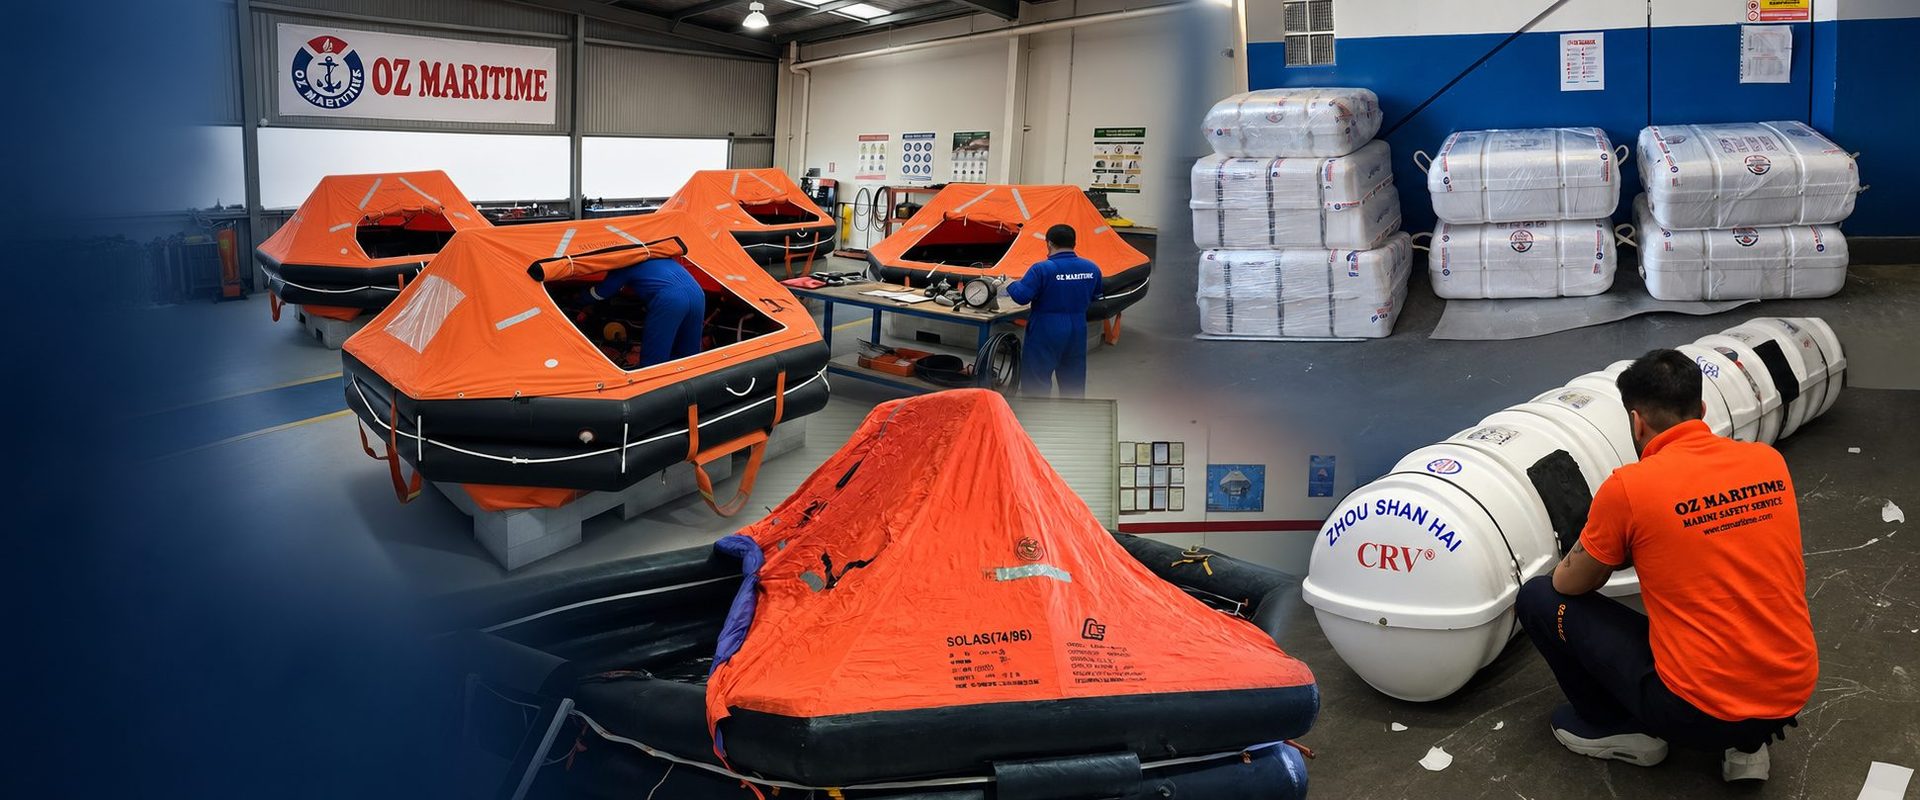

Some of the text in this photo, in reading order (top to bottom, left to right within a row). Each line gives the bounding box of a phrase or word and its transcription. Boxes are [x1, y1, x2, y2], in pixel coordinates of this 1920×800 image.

[371, 56, 548, 102] OZ MARITIME
[1674, 480, 1786, 516] OZ MARITIME
[1719, 504, 1750, 519] SAFETY
[1325, 499, 1463, 553] ZHOU SHAN HAI
